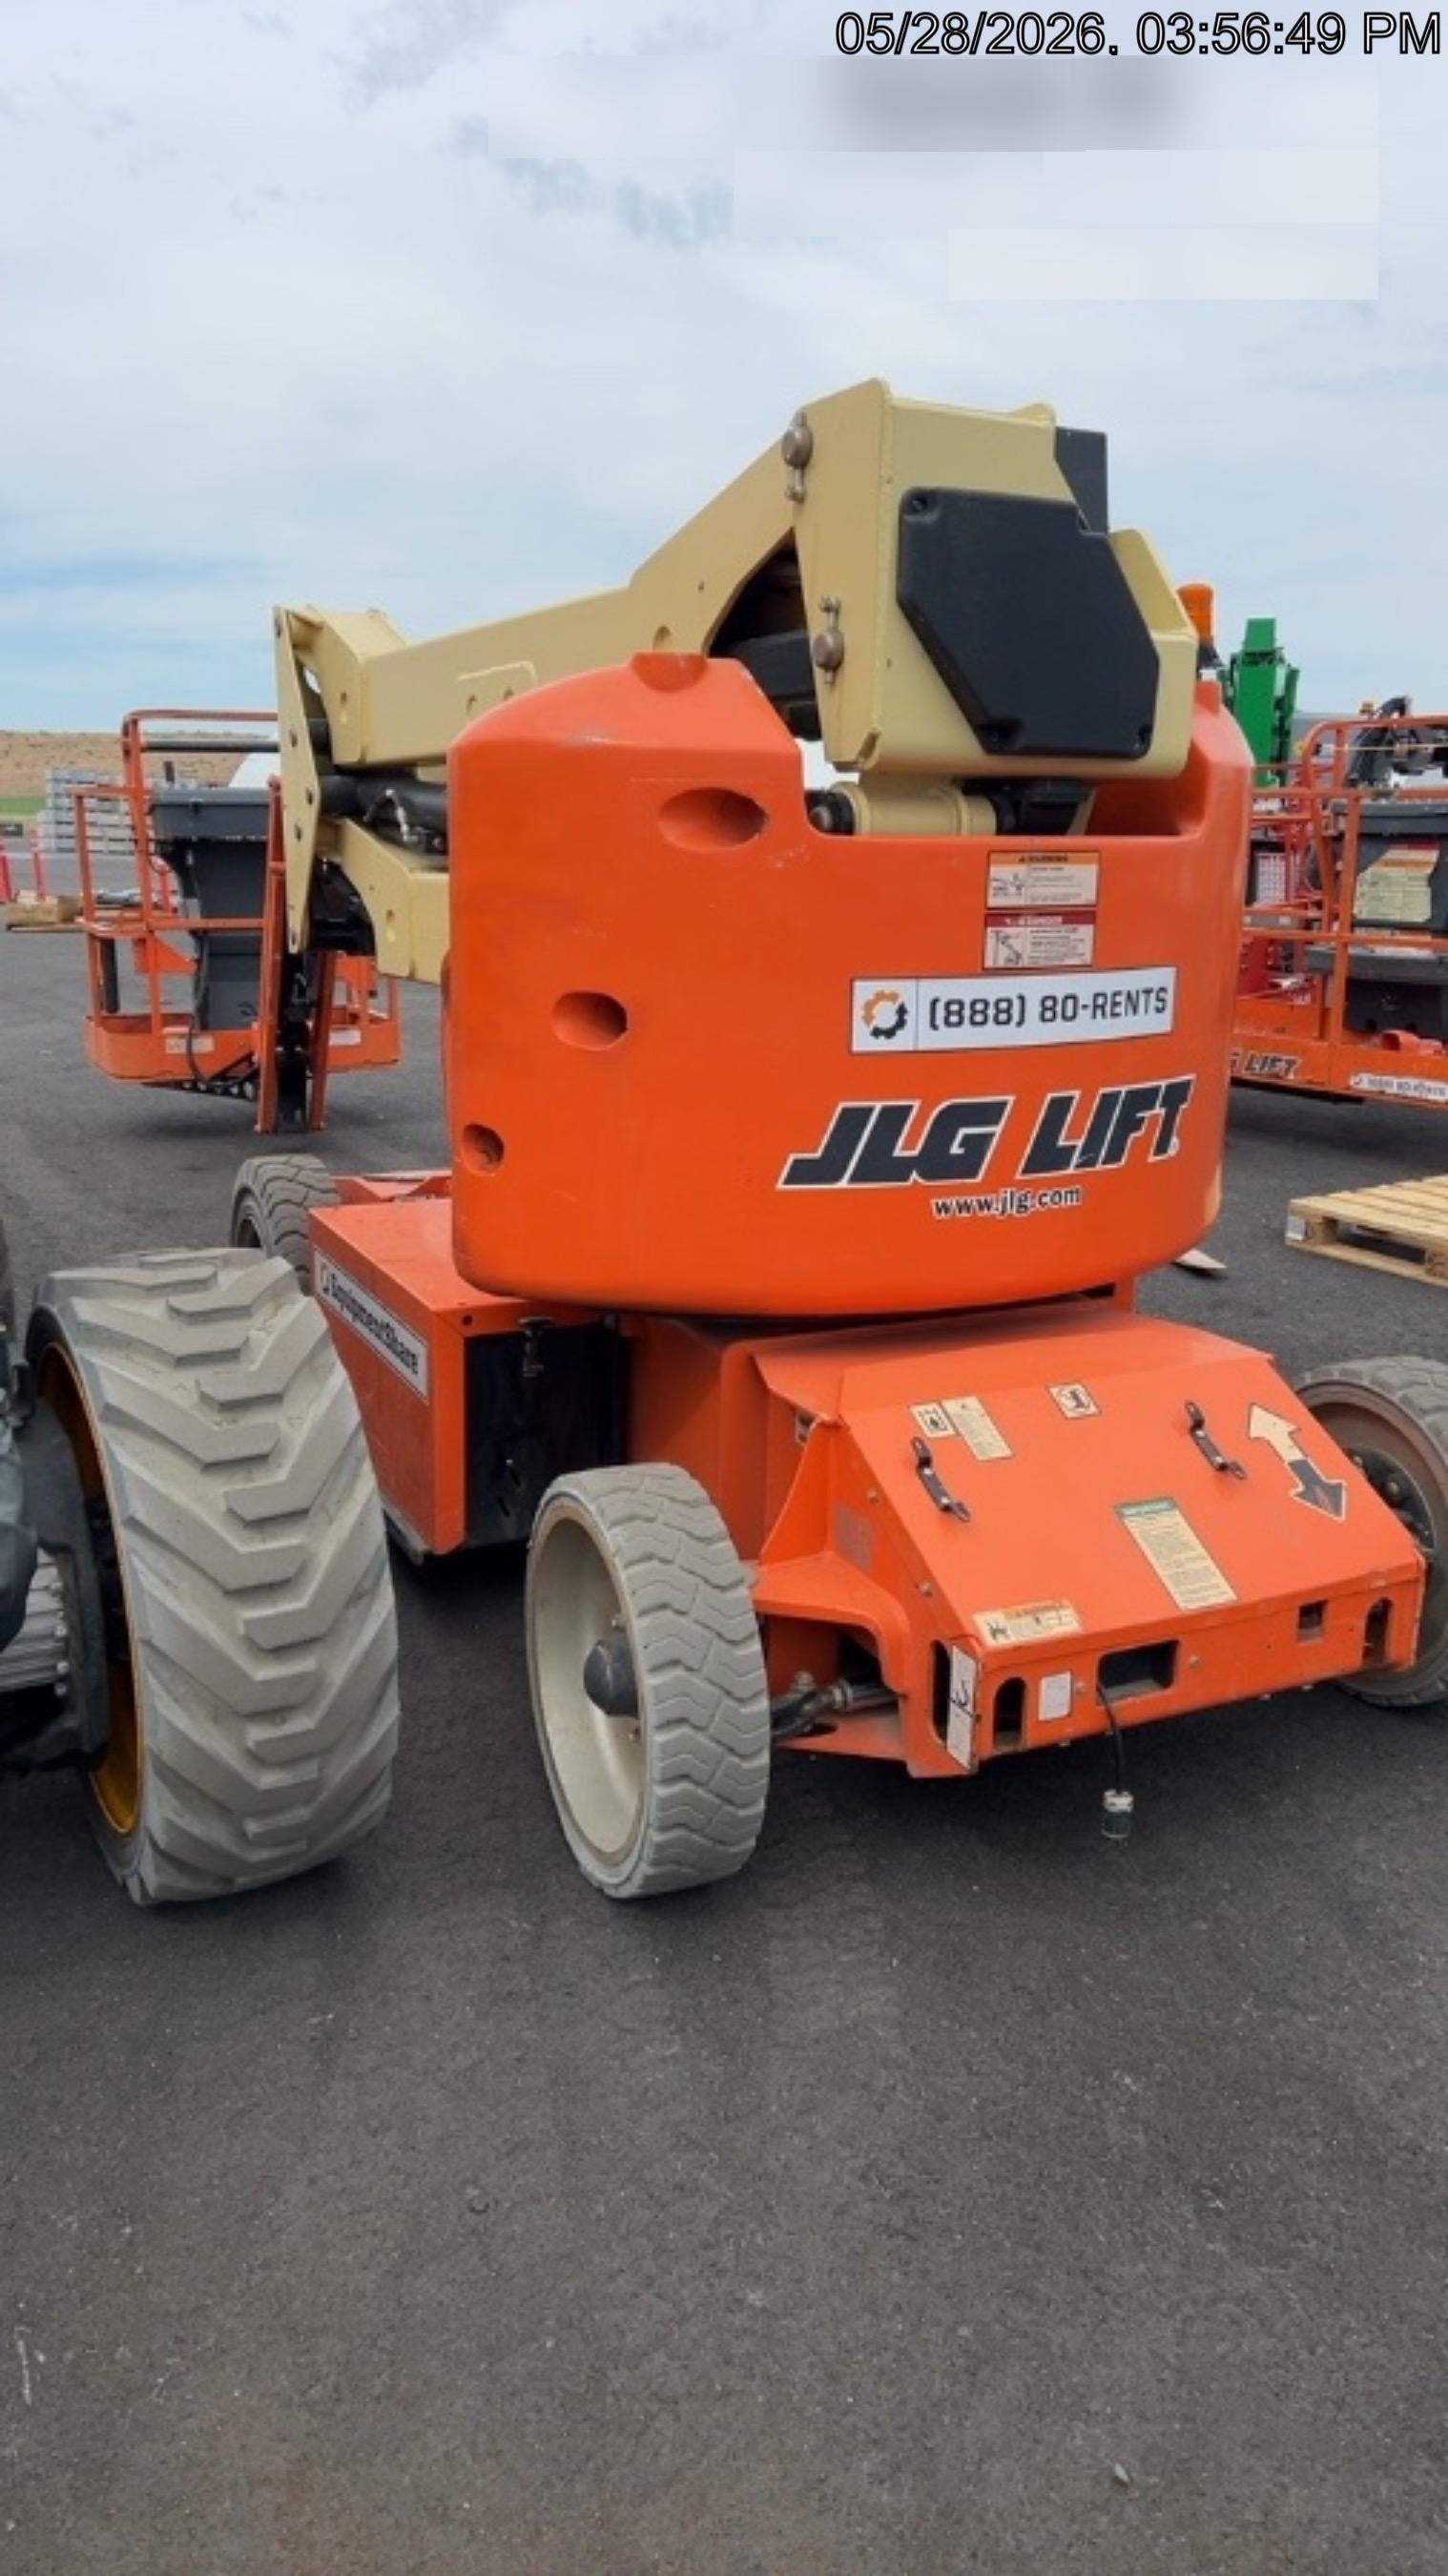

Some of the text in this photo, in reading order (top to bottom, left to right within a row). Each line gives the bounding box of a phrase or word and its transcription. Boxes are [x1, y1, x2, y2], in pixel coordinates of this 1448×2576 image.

[929, 987, 1168, 1030] (888) 80-RENTS
[776, 1073, 1196, 1189] JLG LIFT
[932, 1186, 1082, 1218] www.jlg.com
[331, 1273, 418, 1375] EquipmentShare
